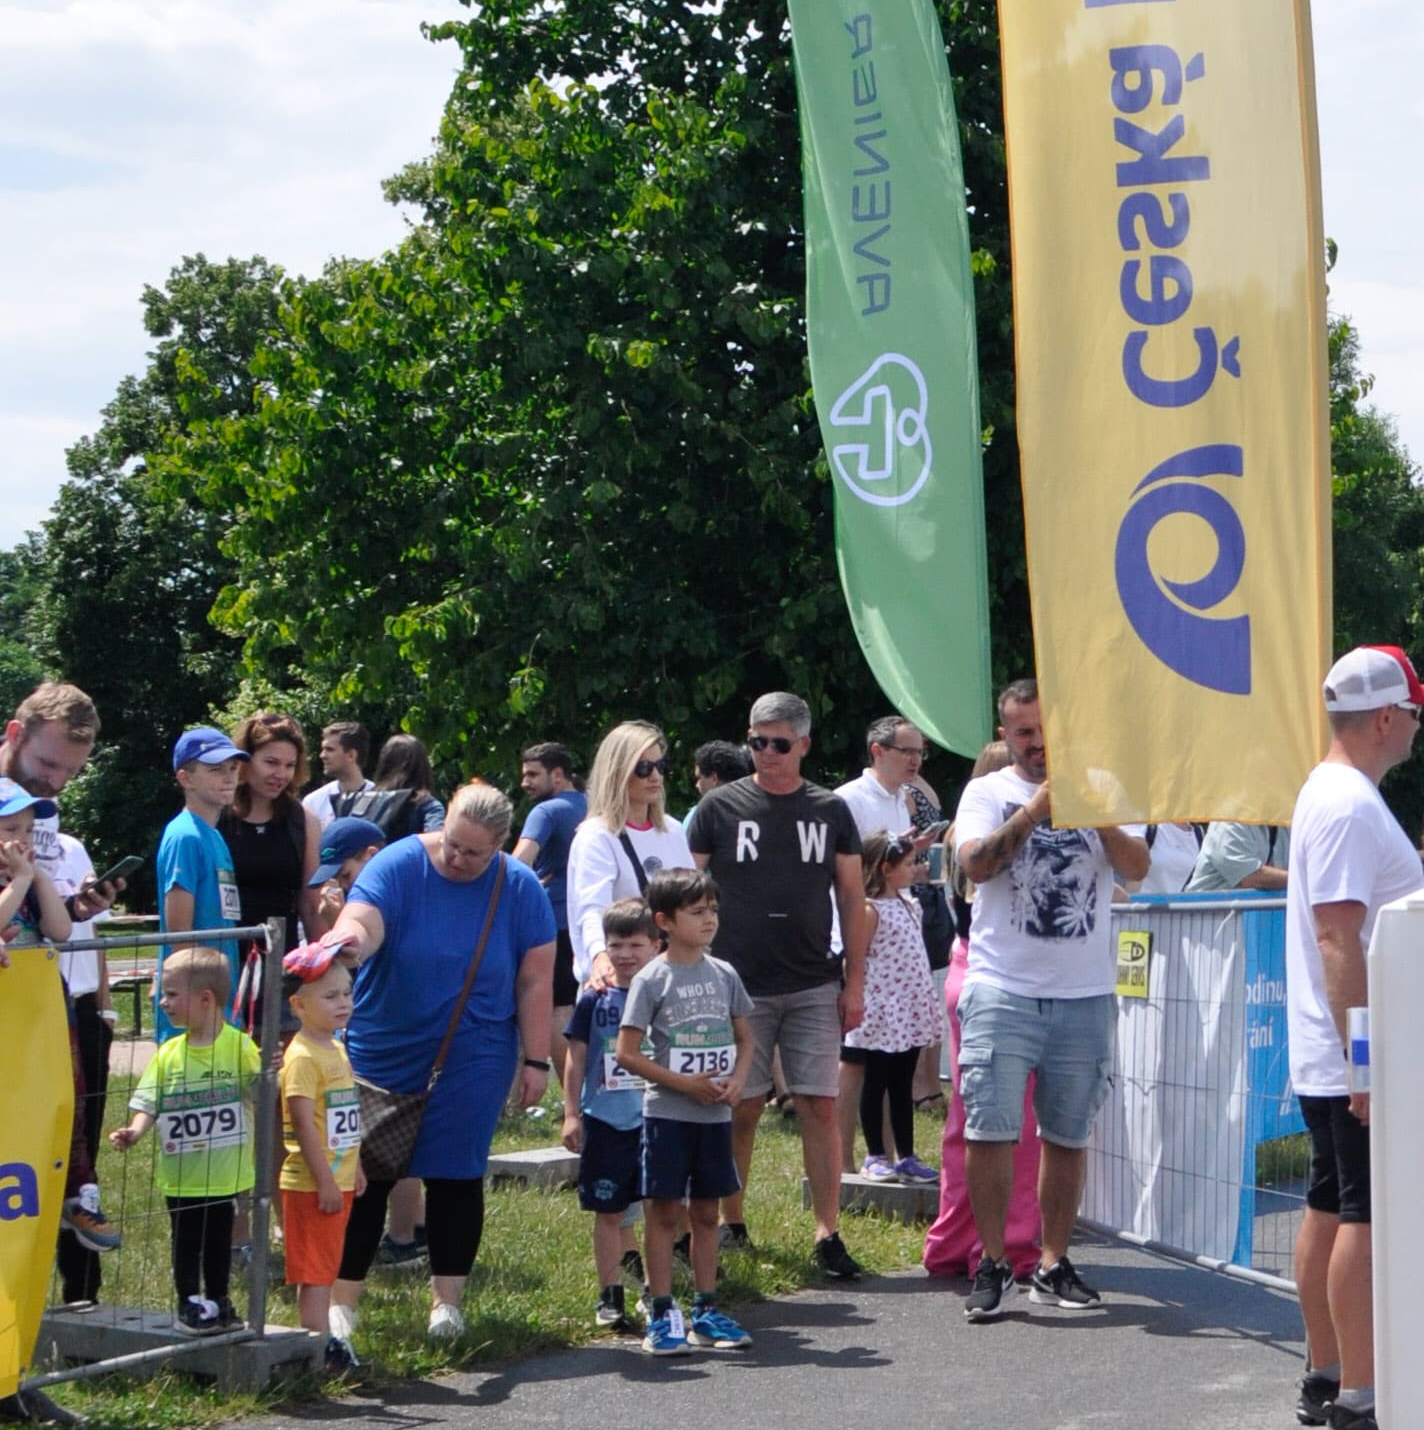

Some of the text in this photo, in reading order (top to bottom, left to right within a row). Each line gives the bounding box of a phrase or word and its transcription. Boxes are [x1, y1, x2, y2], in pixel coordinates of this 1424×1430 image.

[676, 983, 704, 1000] WHO
[680, 1049, 729, 1075] 2136
[167, 1107, 237, 1140] 2079
[334, 1108, 362, 1134] 20
